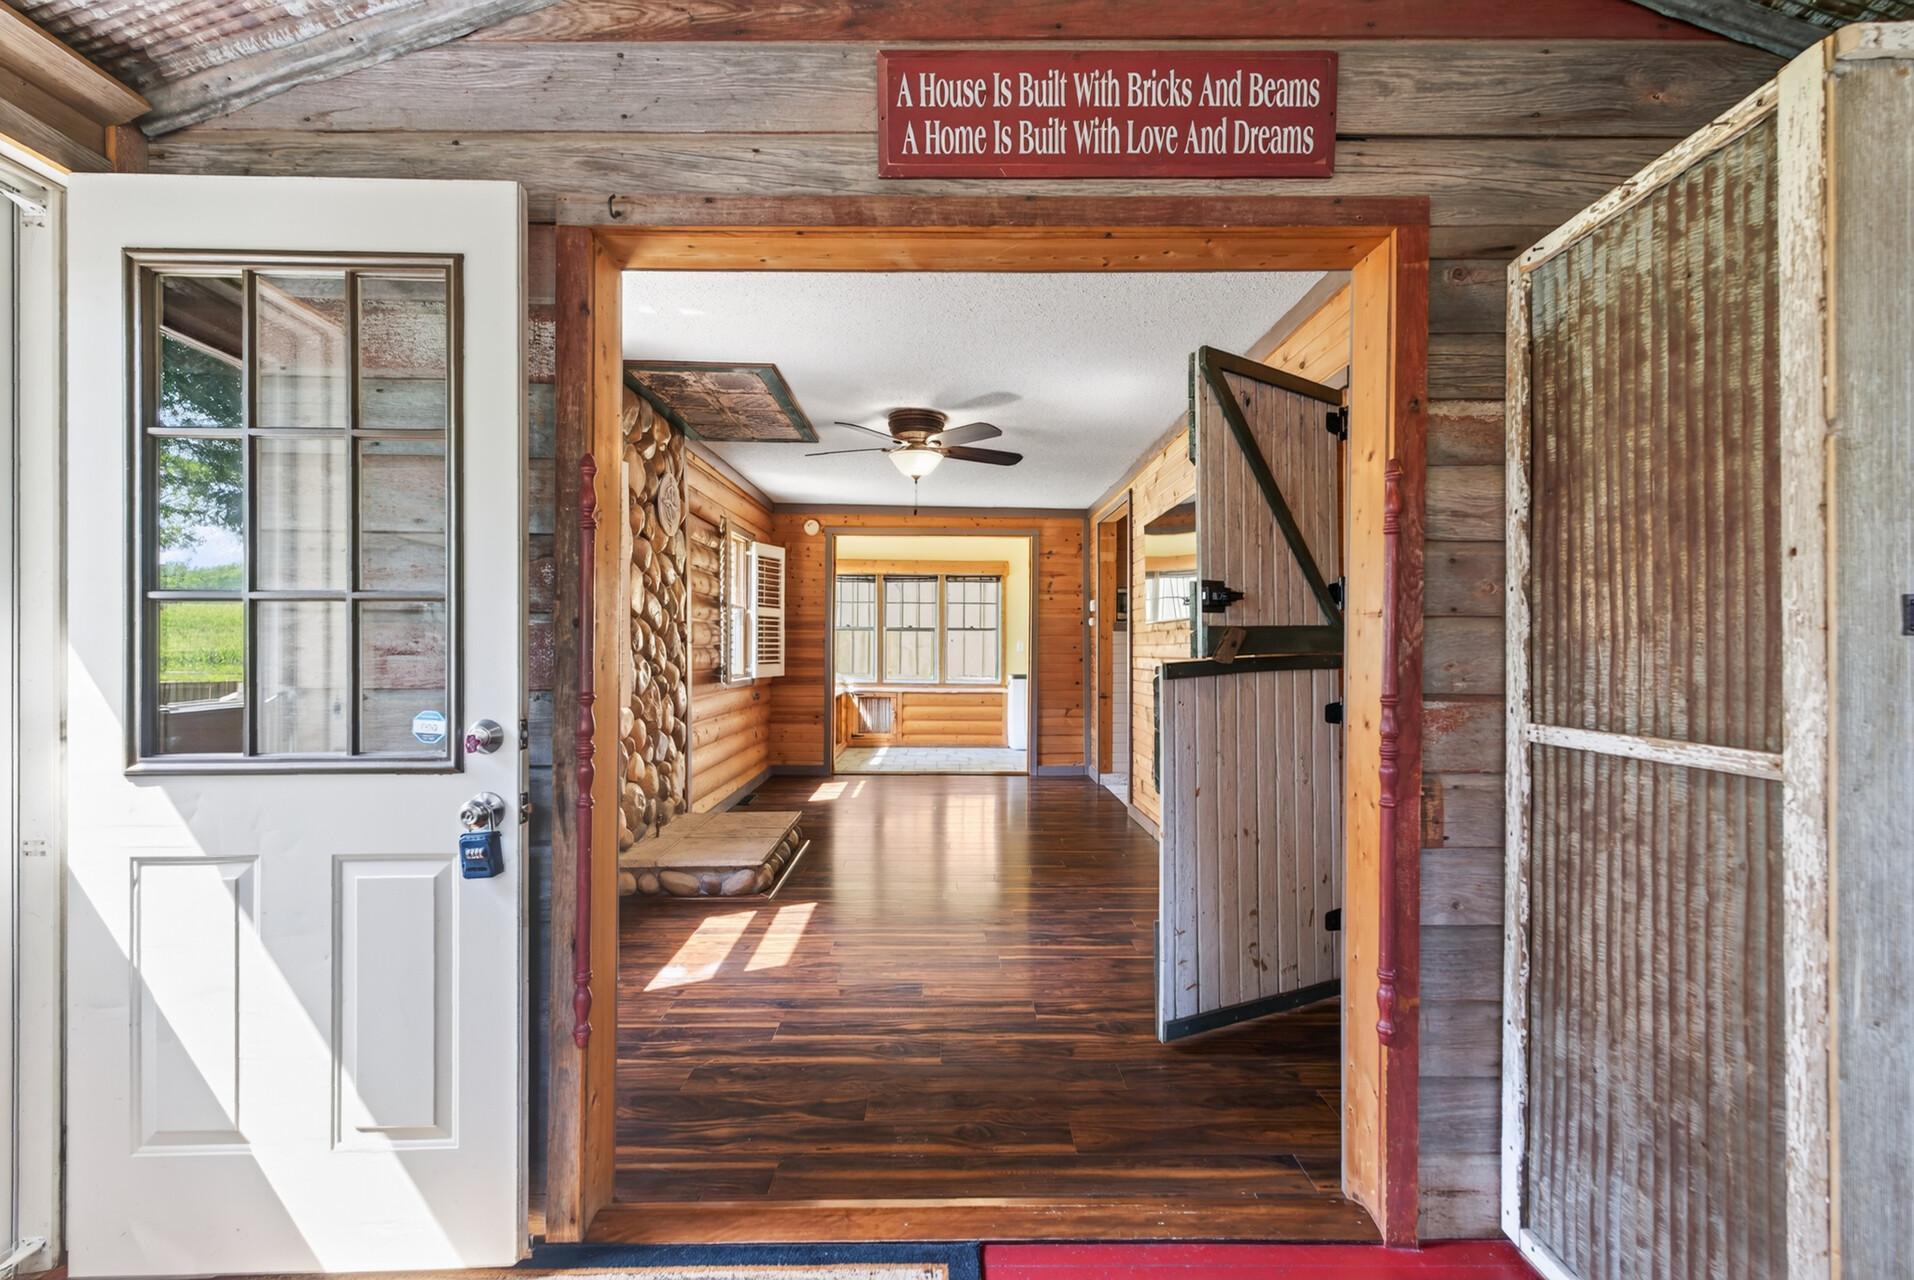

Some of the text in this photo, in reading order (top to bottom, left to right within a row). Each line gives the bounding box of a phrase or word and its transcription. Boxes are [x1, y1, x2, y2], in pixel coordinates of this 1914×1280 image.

[897, 69, 1320, 108] A House Is Built With Bricks And Beams
[902, 117, 1314, 154] A Home Is Built With Love And Dreams
